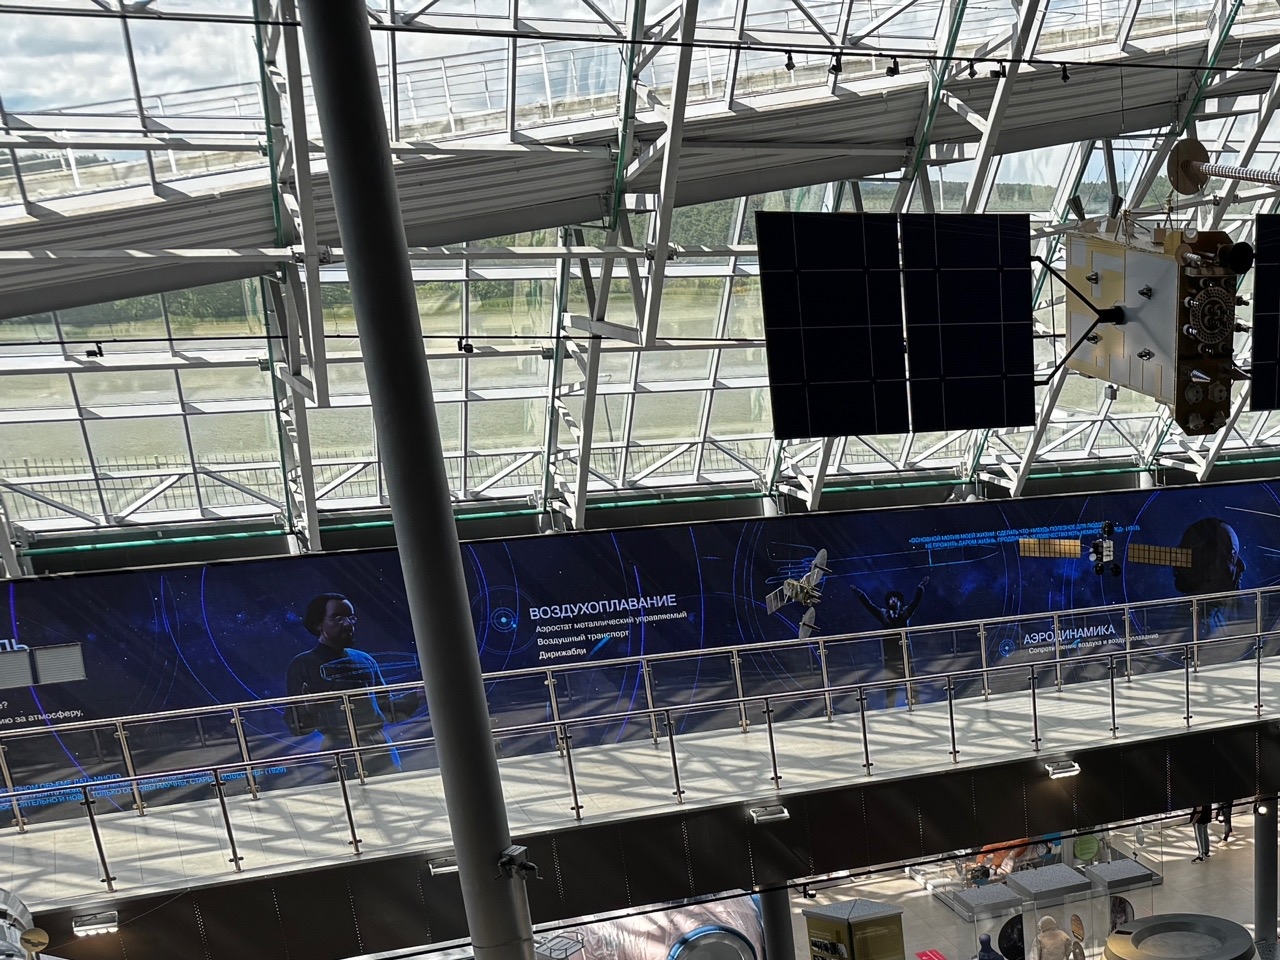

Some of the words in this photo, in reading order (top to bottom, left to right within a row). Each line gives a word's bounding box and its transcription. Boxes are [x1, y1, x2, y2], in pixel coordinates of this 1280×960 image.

[529, 594, 678, 620] ВОЗДУХОПЛАВАНИЕ
[535, 623, 573, 633] Аэростат
[573, 615, 635, 629] металлический
[635, 610, 688, 624] управляемый
[537, 633, 587, 646] Воздушный
[587, 629, 630, 642] транспорт
[1077, 640, 1102, 649] воздуха
[538, 647, 587, 660] Дирижабли
[28, 710, 84, 721] атмосферу,
[91, 787, 122, 798] ТОЛЬКО
[122, 782, 156, 794] ОСОВЫ
